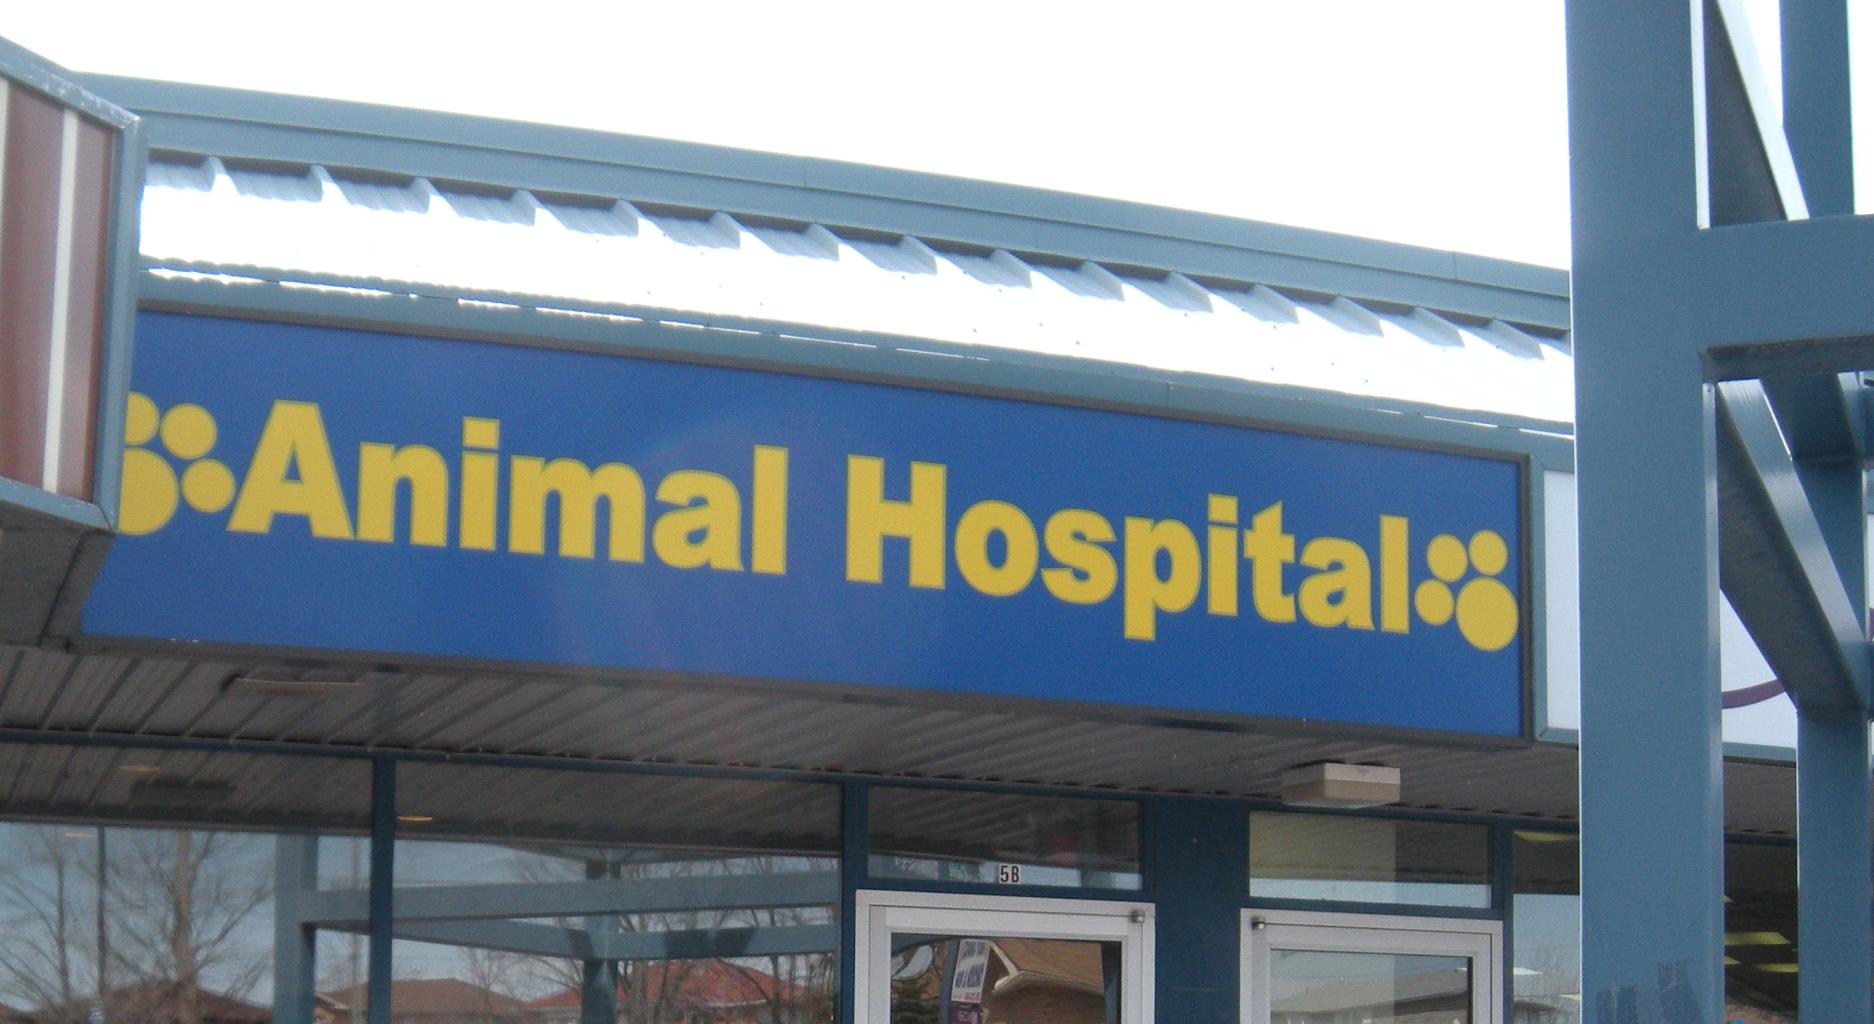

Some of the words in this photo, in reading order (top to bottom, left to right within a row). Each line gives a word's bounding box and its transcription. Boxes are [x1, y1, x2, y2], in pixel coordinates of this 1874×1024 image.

[227, 399, 788, 576] Animal
[845, 455, 1411, 641] Hospital
[1000, 865, 1020, 883] 5B
